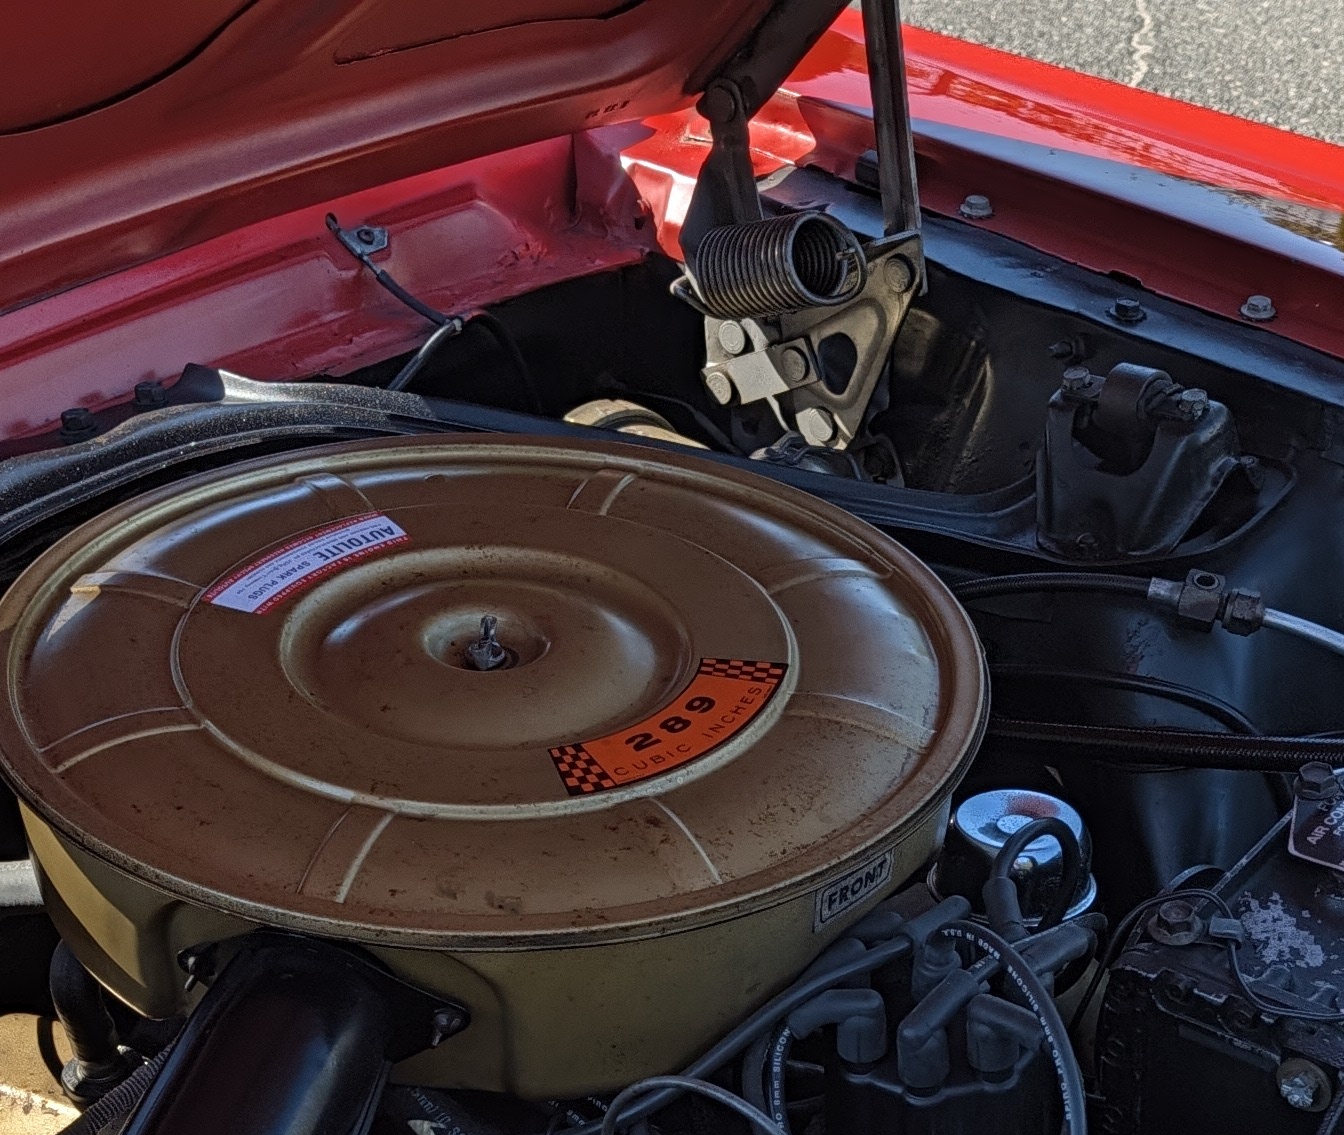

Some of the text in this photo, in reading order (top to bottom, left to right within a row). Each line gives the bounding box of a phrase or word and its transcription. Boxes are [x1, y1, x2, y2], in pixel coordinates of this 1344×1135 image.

[313, 524, 394, 562] AUTOLITE
[275, 559, 310, 580] SPARK
[248, 579, 276, 600] PLUGS
[613, 685, 763, 777] CUBIC INCHES
[625, 696, 716, 752] 289
[1306, 823, 1331, 845] AIR
[827, 859, 888, 912] FRONT
[966, 932, 974, 941] IN
[978, 938, 1000, 959] MADE
[1007, 965, 1038, 1011] SILICONE
[773, 1026, 790, 1072] SILICON
[1052, 1049, 1063, 1074] PRO
